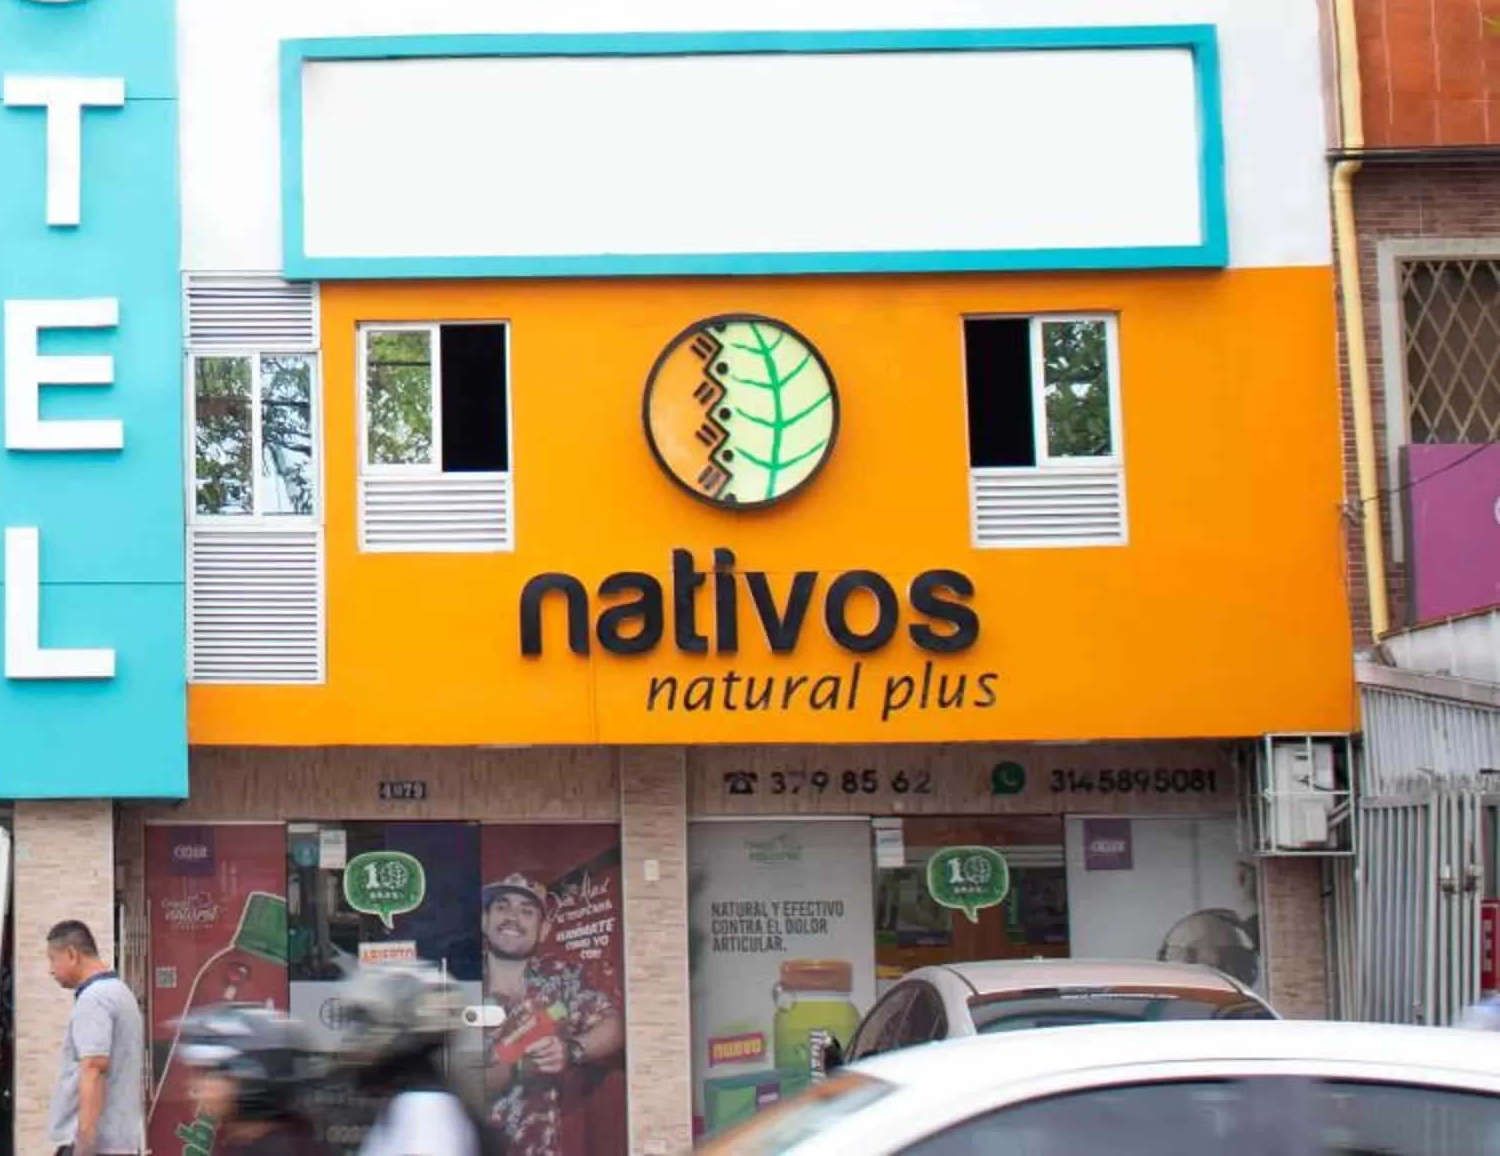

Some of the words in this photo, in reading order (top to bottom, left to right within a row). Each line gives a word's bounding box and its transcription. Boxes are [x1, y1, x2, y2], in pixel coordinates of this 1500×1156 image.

[519, 547, 982, 657] nativos
[646, 662, 862, 712] natural
[880, 661, 998, 722] plus
[771, 771, 830, 794] 379
[842, 769, 878, 794] 85
[891, 769, 931, 794] 62
[711, 900, 768, 917] NATURAL
[783, 899, 844, 917] EFECTIVO
[711, 918, 764, 935] CONTRA
[767, 918, 782, 935] EL
[785, 917, 828, 934] DOLOR
[711, 935, 787, 952] ARTICULAR.
